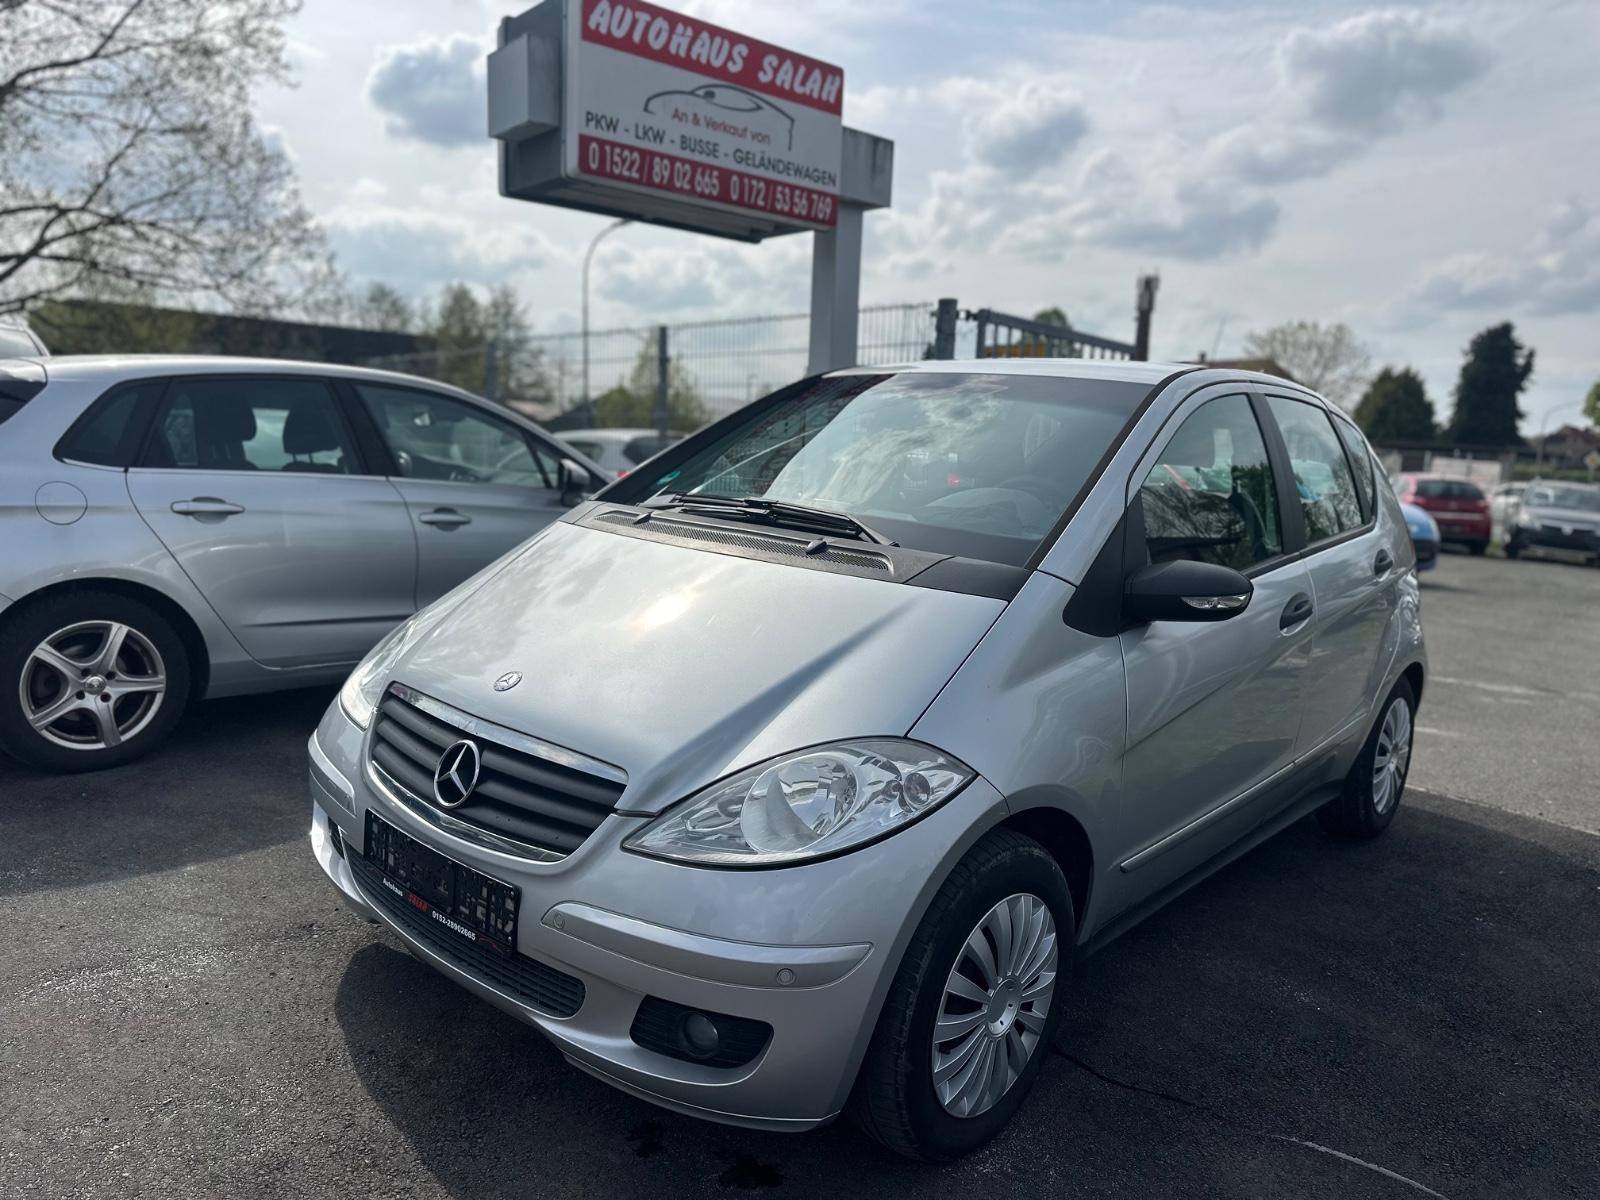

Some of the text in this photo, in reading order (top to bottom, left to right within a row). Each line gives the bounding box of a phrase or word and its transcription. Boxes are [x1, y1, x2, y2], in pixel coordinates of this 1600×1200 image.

[588, 0, 840, 104] AUTOHAUS SALAH
[585, 110, 620, 134] PKW
[635, 122, 666, 144] LKW
[680, 134, 720, 159] BUSSE
[732, 148, 838, 187] GELÄNDEWAGEN
[672, 107, 771, 145] An & Verkauf von
[588, 141, 600, 171] 0
[604, 144, 641, 180] 1522
[651, 156, 671, 185] 89
[673, 161, 692, 191] 02
[694, 167, 720, 197] 665
[730, 174, 740, 201] 0
[742, 177, 766, 208] 172
[775, 185, 791, 213] 53
[792, 189, 809, 216] 56
[810, 193, 833, 220] 769
